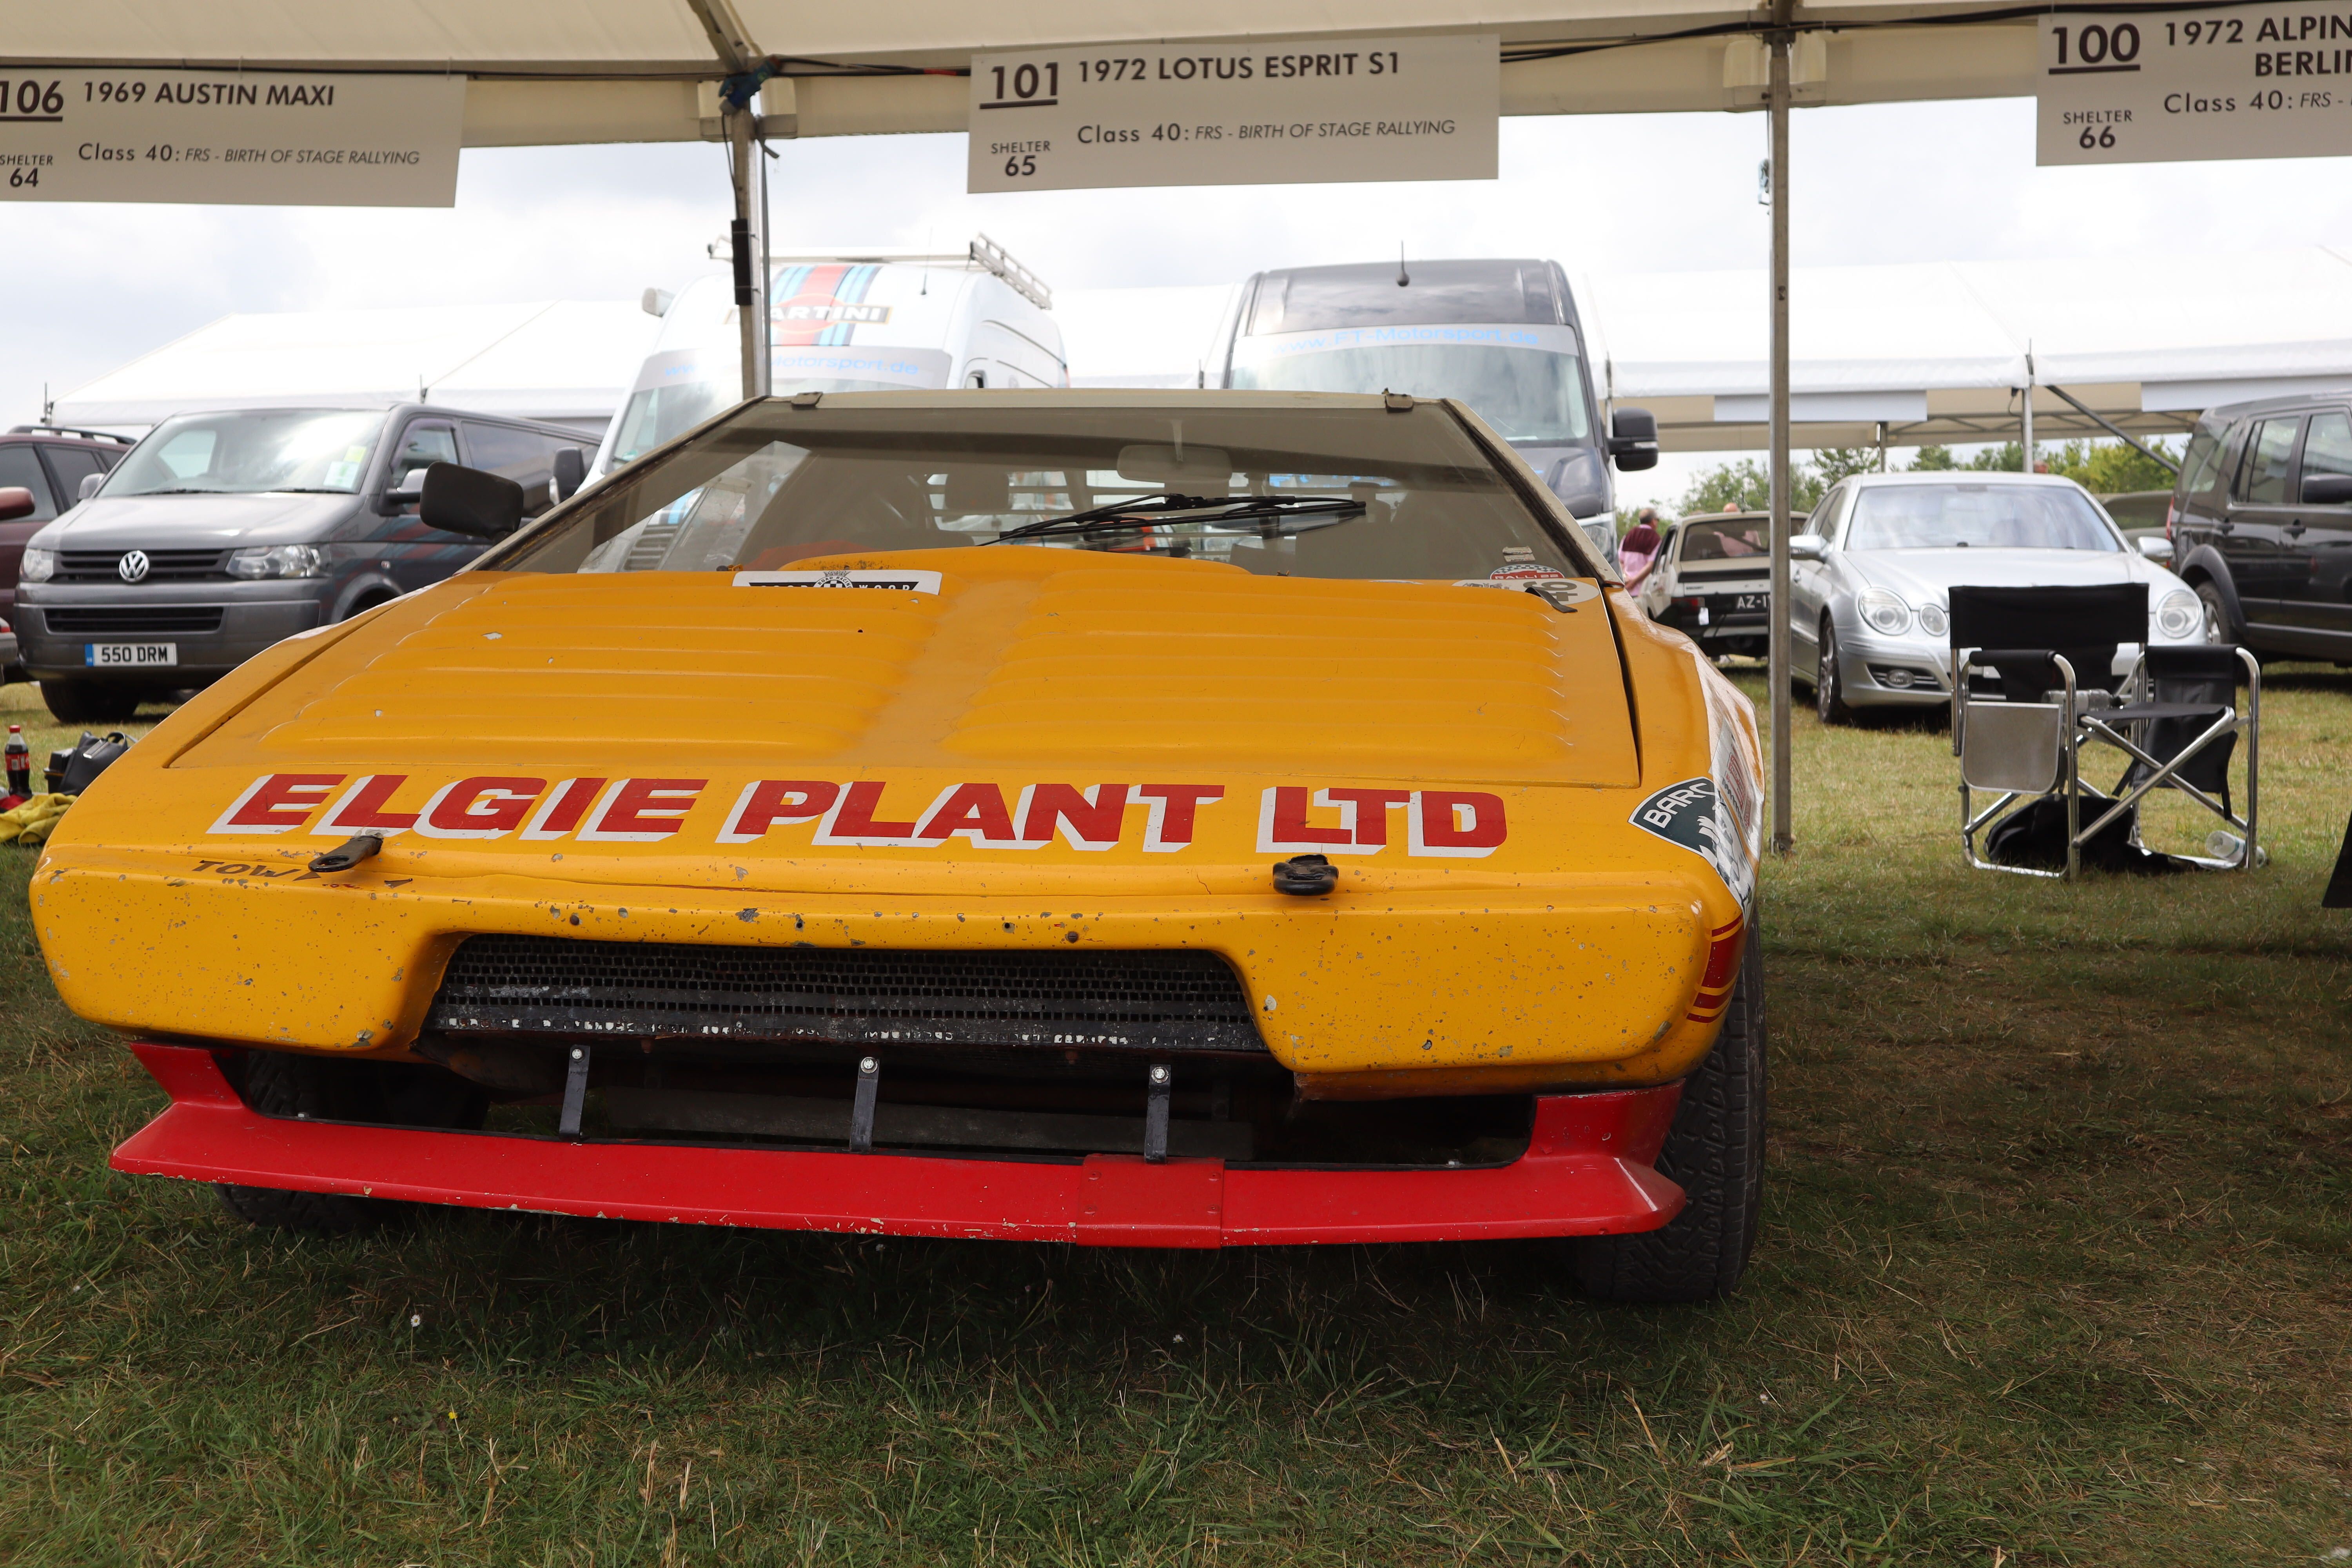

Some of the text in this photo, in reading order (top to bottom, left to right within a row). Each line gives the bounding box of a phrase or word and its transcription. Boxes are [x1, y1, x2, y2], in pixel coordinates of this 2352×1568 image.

[2165, 14, 2352, 46] 1972 ALPIN
[2052, 23, 2141, 64] 100
[1079, 52, 1398, 82] 1972 LOTUS ESPRIT S1
[991, 62, 1058, 99] 101
[0, 80, 64, 113] 106
[84, 82, 334, 106] 1969 AUSTIN MAXI
[2164, 92, 2236, 114] Class
[2249, 90, 2292, 110] 40:
[2300, 92, 2331, 108] FRS
[2063, 110, 2133, 124] SHELTER
[1077, 124, 1140, 144] Class
[1151, 123, 1189, 141] 40:
[1195, 125, 1223, 140] FRS
[1238, 124, 1285, 139] BIRTH
[1289, 123, 1314, 138] OF
[1318, 122, 1372, 137] STAGE
[1376, 120, 1455, 135] RALLYING
[2079, 125, 2116, 149] 66
[78, 142, 134, 161] Class
[145, 144, 180, 162] 40:
[185, 148, 211, 162] FRS
[224, 149, 266, 162] BIRTH
[270, 149, 293, 163] OF
[296, 149, 345, 164] STAGE
[348, 150, 420, 165] RALLYING
[991, 140, 1051, 154] SHELTER
[0, 154, 53, 166] SHELTER
[1005, 155, 1036, 177] 65
[9, 167, 39, 188] 64
[735, 305, 881, 322] ARTINI
[818, 577, 833, 585] ROAD
[1737, 595, 1771, 608] AZ-1
[102, 646, 167, 662] 550 DRM
[205, 774, 1508, 858] ELGIE PLANT LTD
[1643, 782, 1715, 829] BARC
[192, 860, 301, 877] TOW
